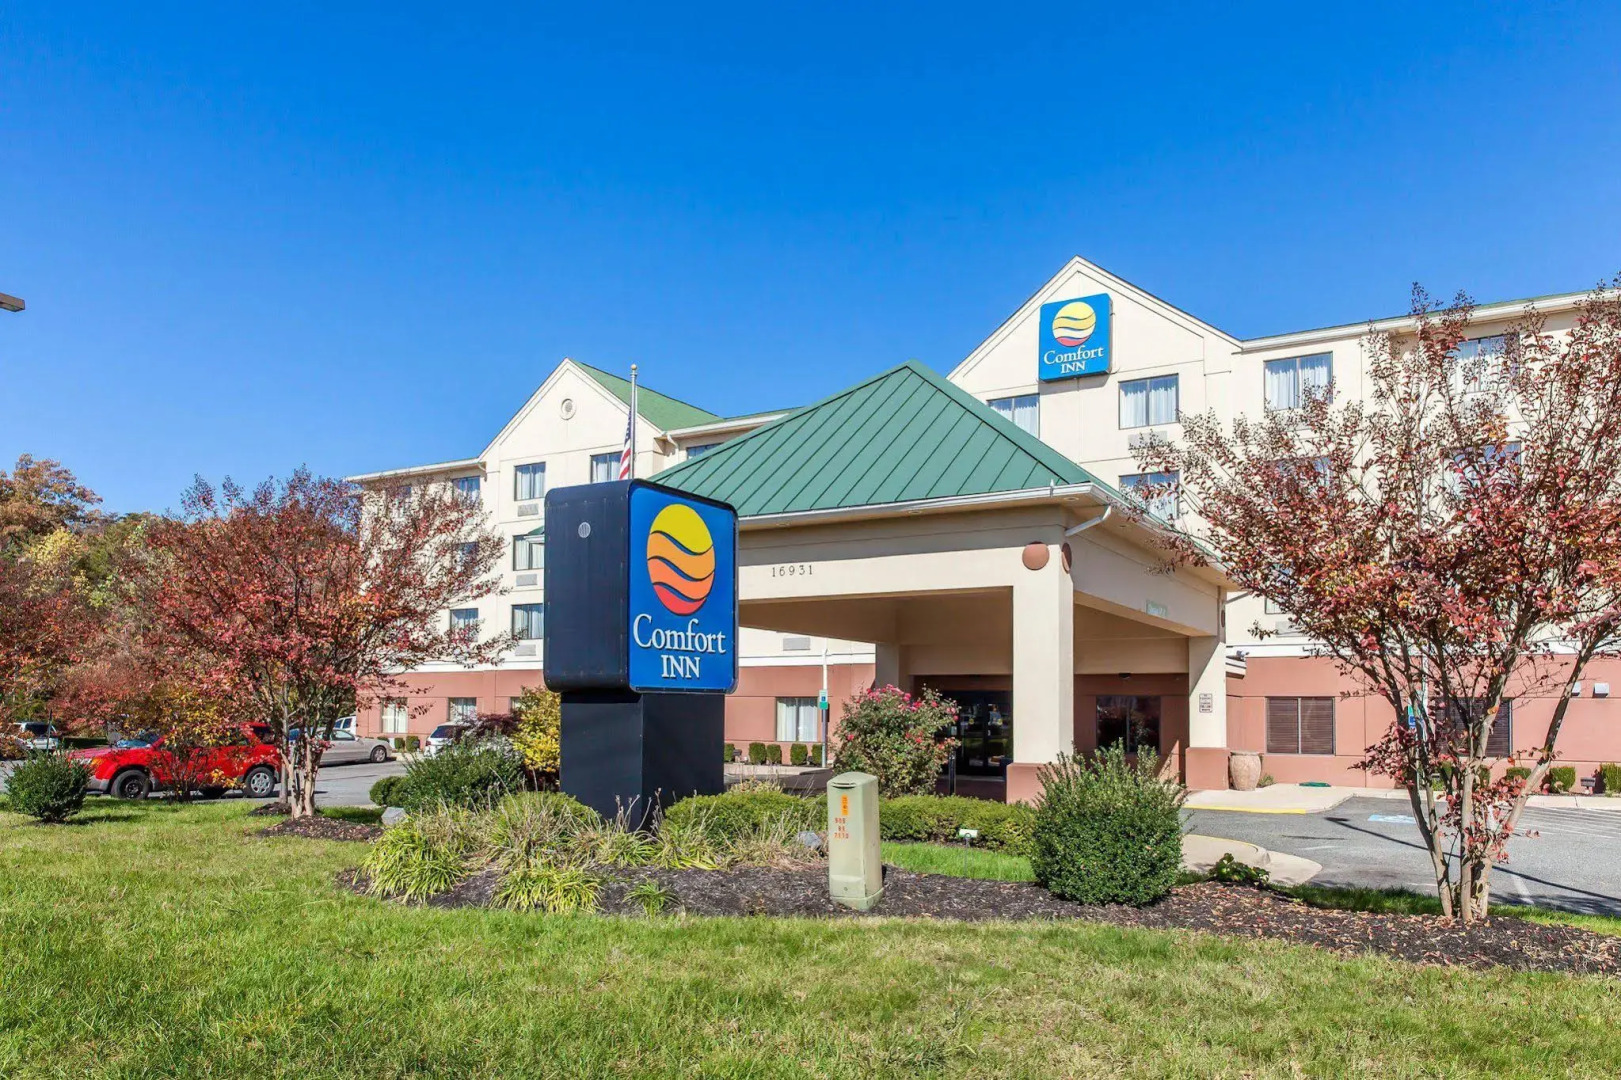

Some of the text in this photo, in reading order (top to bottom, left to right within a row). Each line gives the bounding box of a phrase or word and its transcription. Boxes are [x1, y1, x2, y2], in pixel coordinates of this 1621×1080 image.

[1043, 345, 1104, 365] Comfort
[1060, 361, 1086, 374] INN
[772, 565, 813, 577] 16931
[633, 613, 727, 654] Comfort
[660, 654, 700, 678] INN
